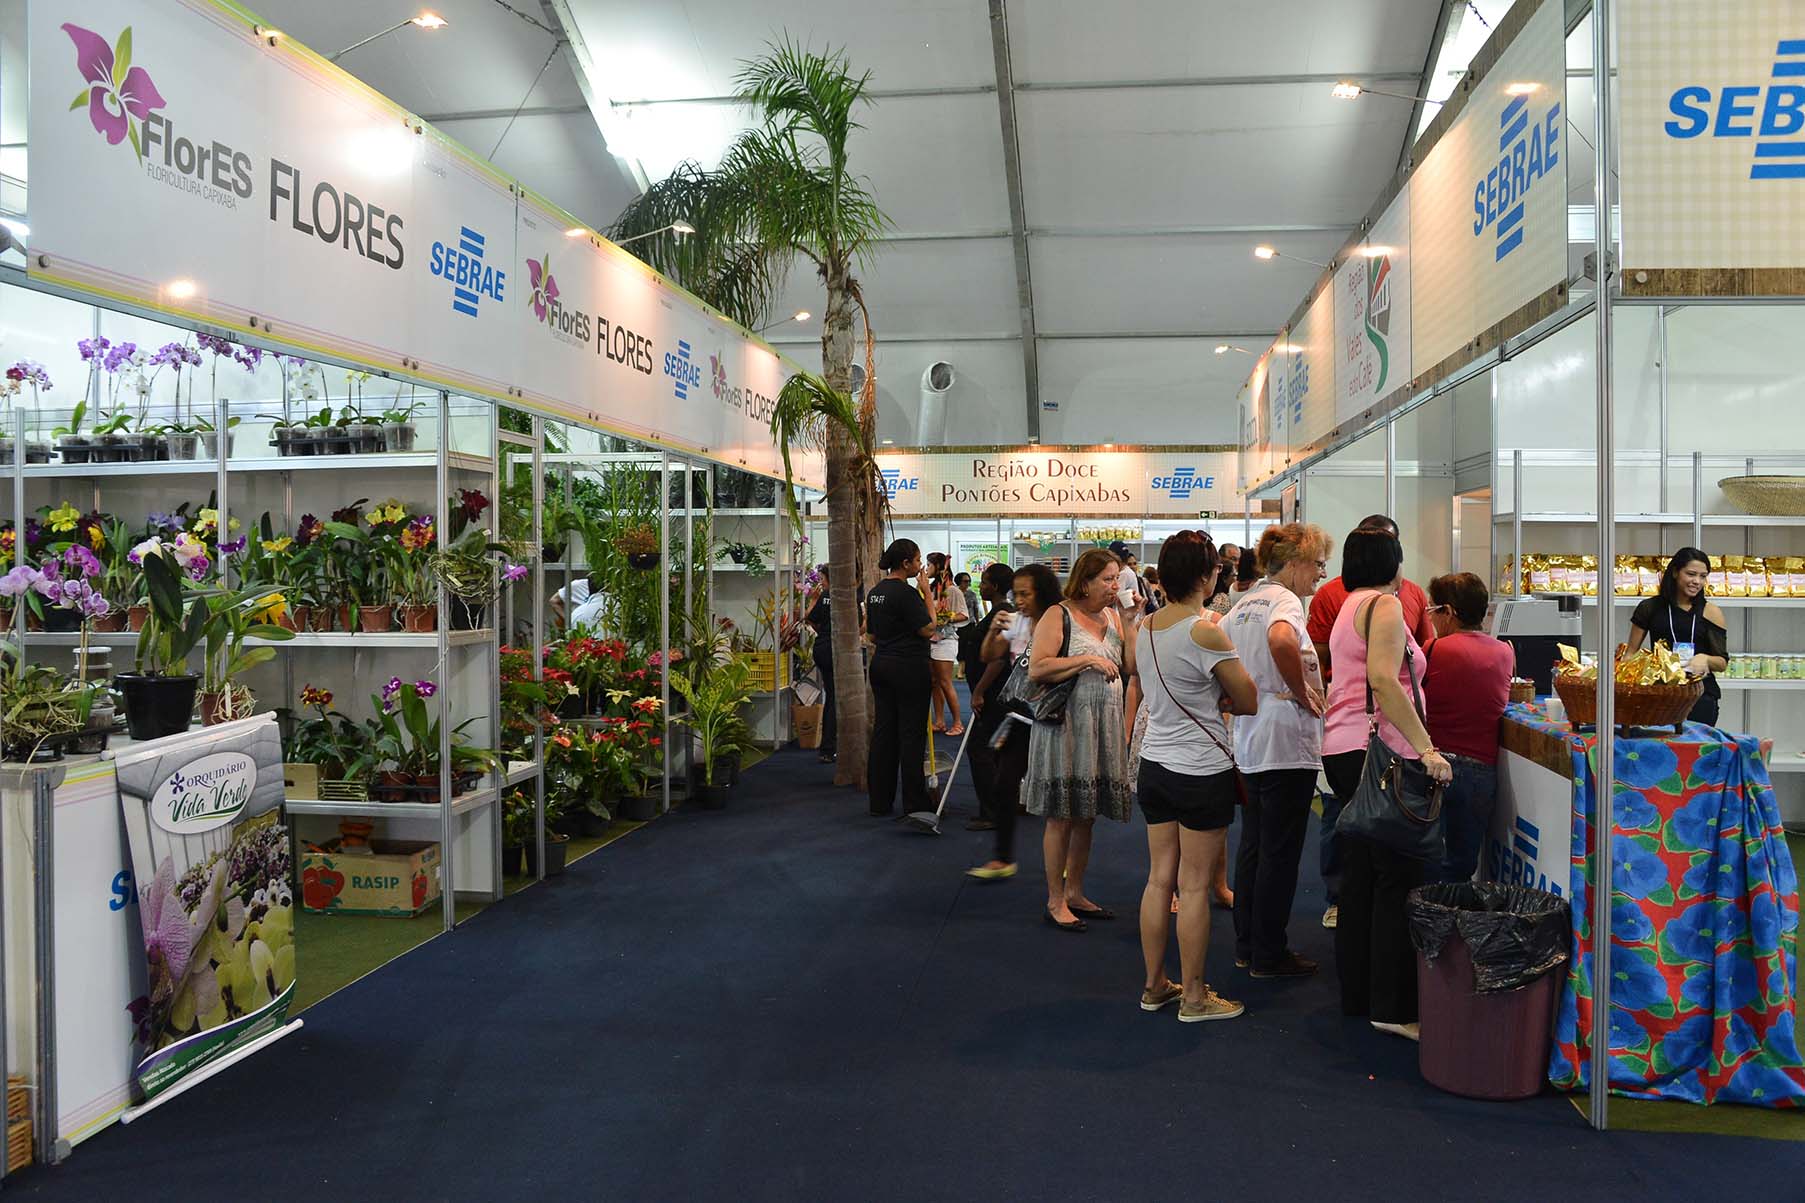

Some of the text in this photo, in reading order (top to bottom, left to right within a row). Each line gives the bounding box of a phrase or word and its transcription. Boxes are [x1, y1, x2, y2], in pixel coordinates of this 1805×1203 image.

[141, 112, 252, 199] FlorES
[1474, 101, 1560, 236] SEBRAE
[147, 162, 238, 212] FLORICULTURA CAPIXABA
[270, 157, 404, 270] FLORES
[430, 241, 505, 302] SEBRAE
[551, 299, 590, 342] FlorES
[597, 316, 653, 375] FLORES
[664, 352, 701, 388] SEBRAE
[1151, 477, 1215, 489] SEBRAE
[870, 595, 885, 604] STAFF
[186, 761, 246, 788] ORQUIDÁRIO
[168, 778, 247, 822] Vida Verde
[352, 876, 400, 889] RASIP
